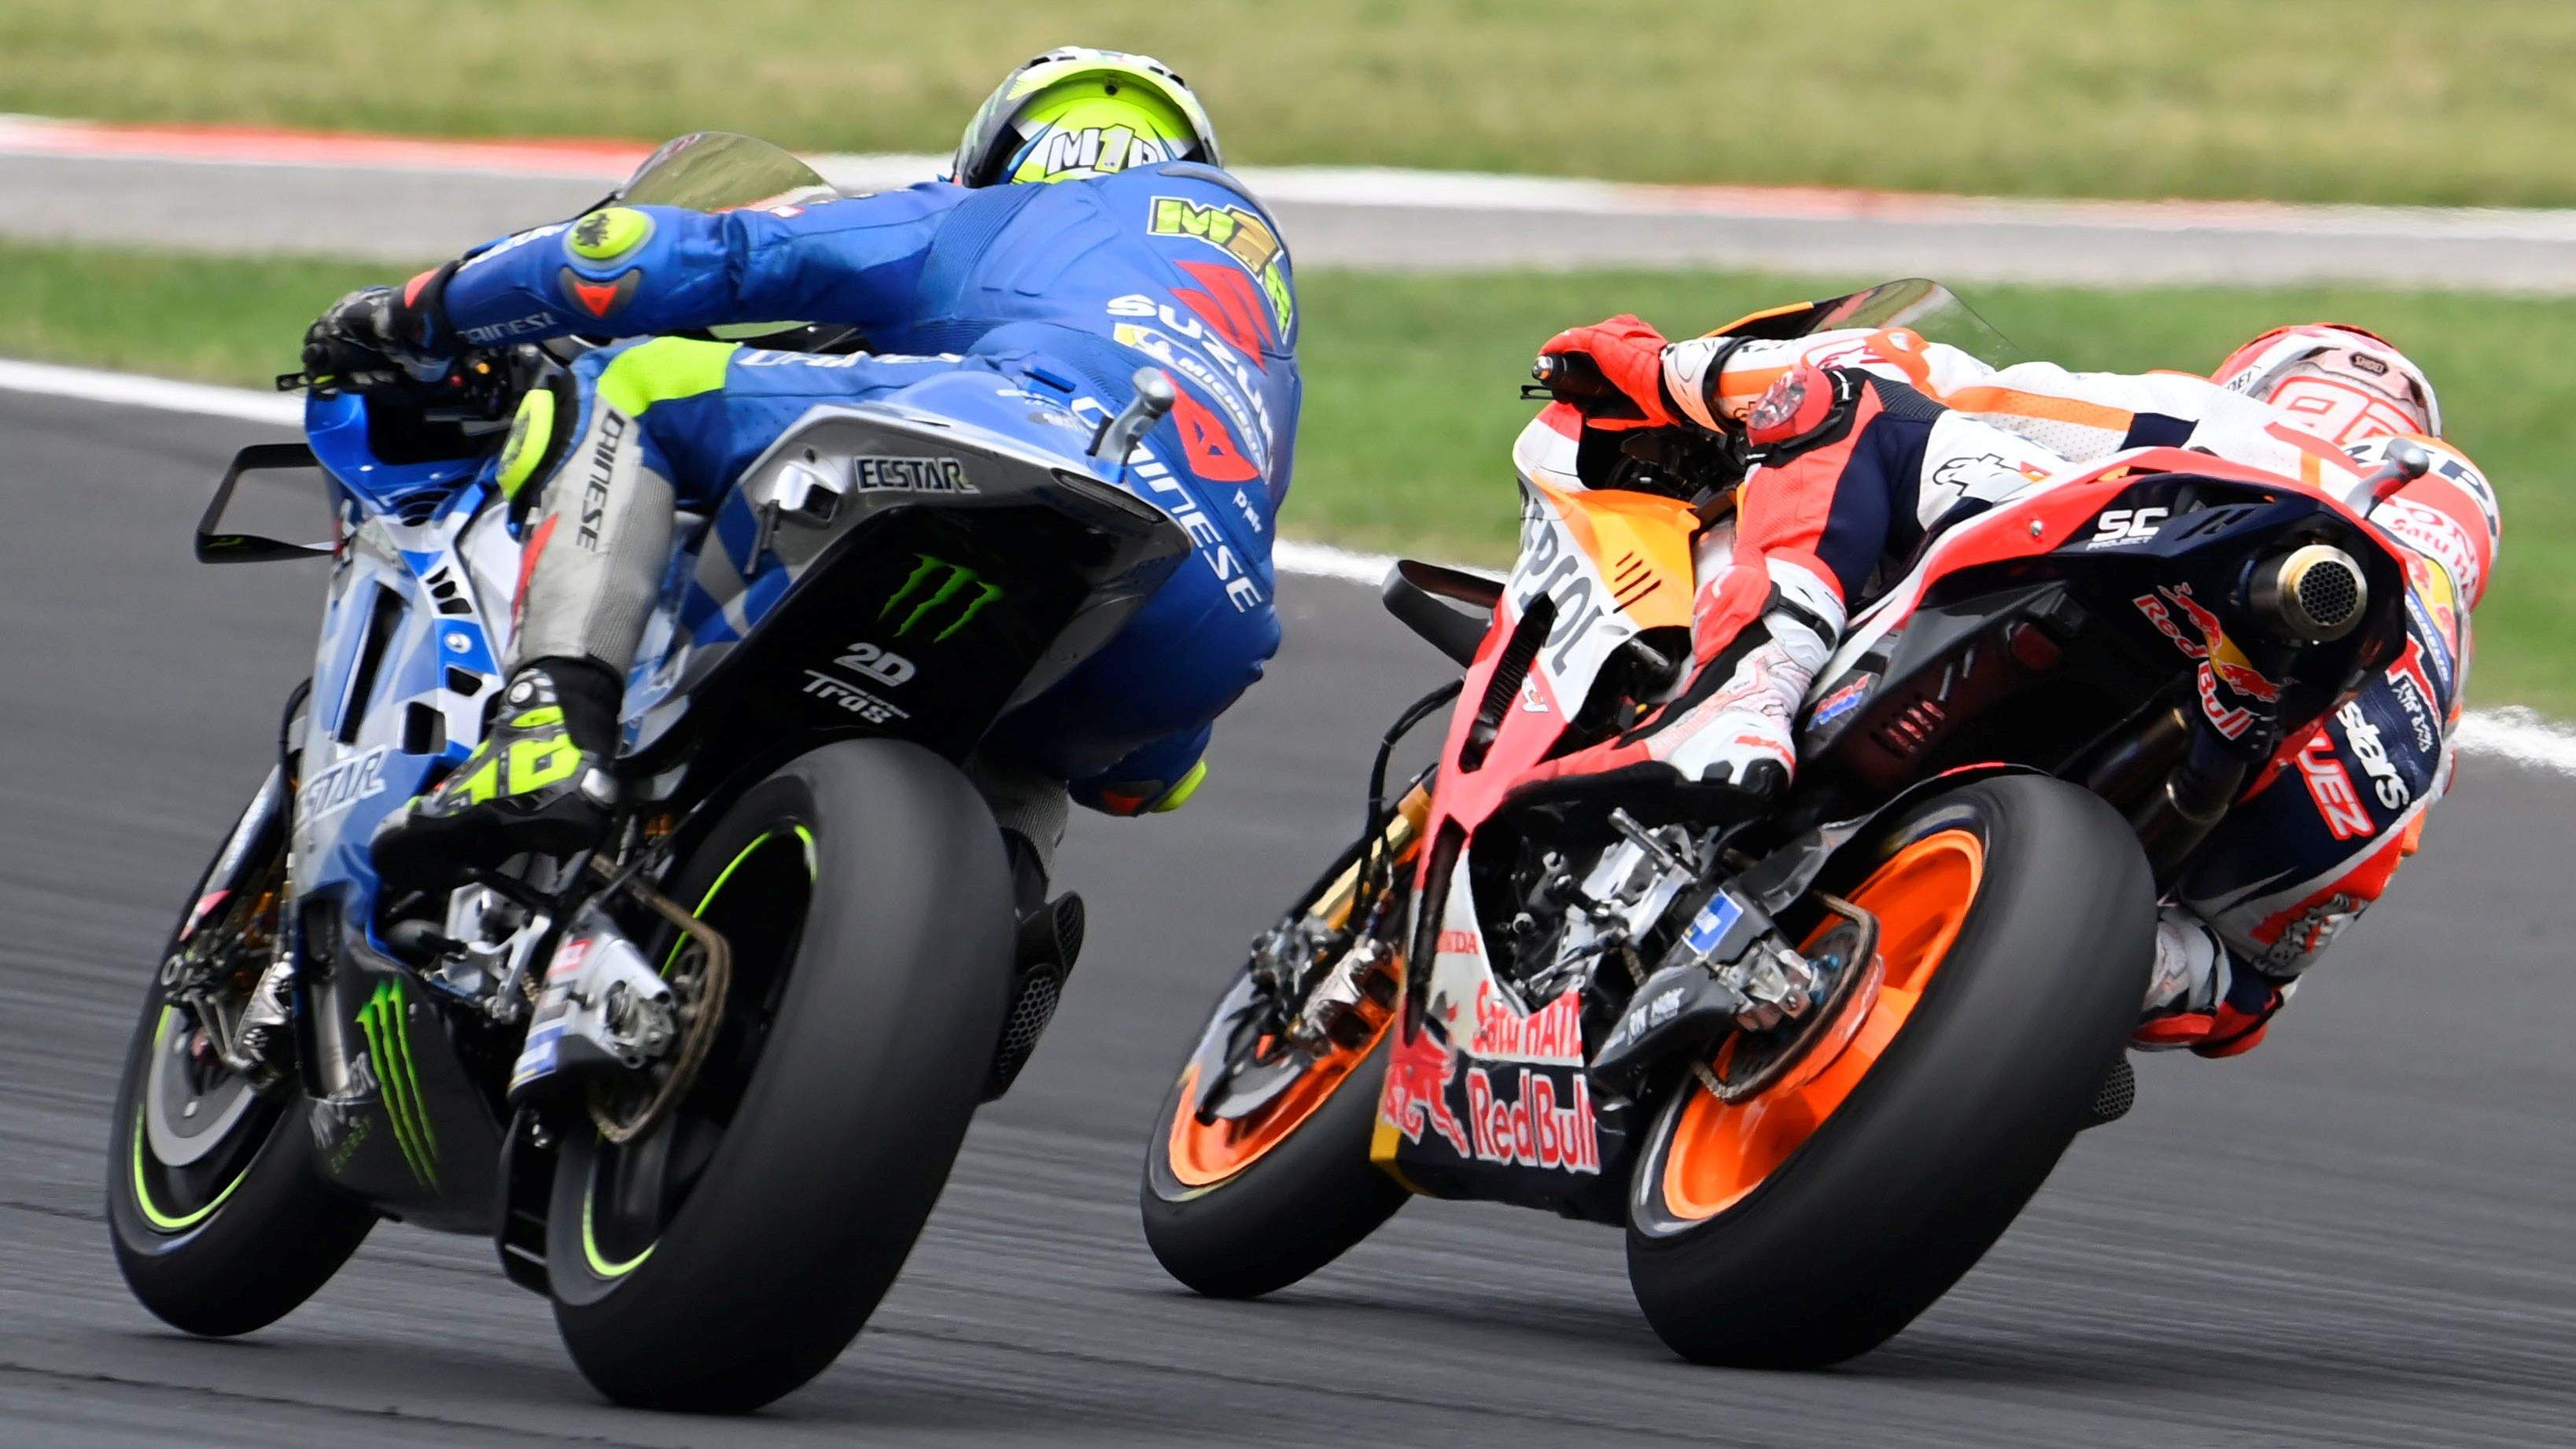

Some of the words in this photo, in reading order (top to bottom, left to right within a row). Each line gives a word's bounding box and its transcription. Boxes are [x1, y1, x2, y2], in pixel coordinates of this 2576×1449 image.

[576, 409, 627, 552] DAINESE
[854, 455, 981, 494] ECSTAR
[2091, 507, 2169, 542] SC
[832, 642, 916, 688] 2D
[2132, 593, 2210, 659] Red
[2197, 659, 2255, 741] Bull
[1465, 1067, 1539, 1167] Red
[1532, 1074, 1601, 1175] Bull
